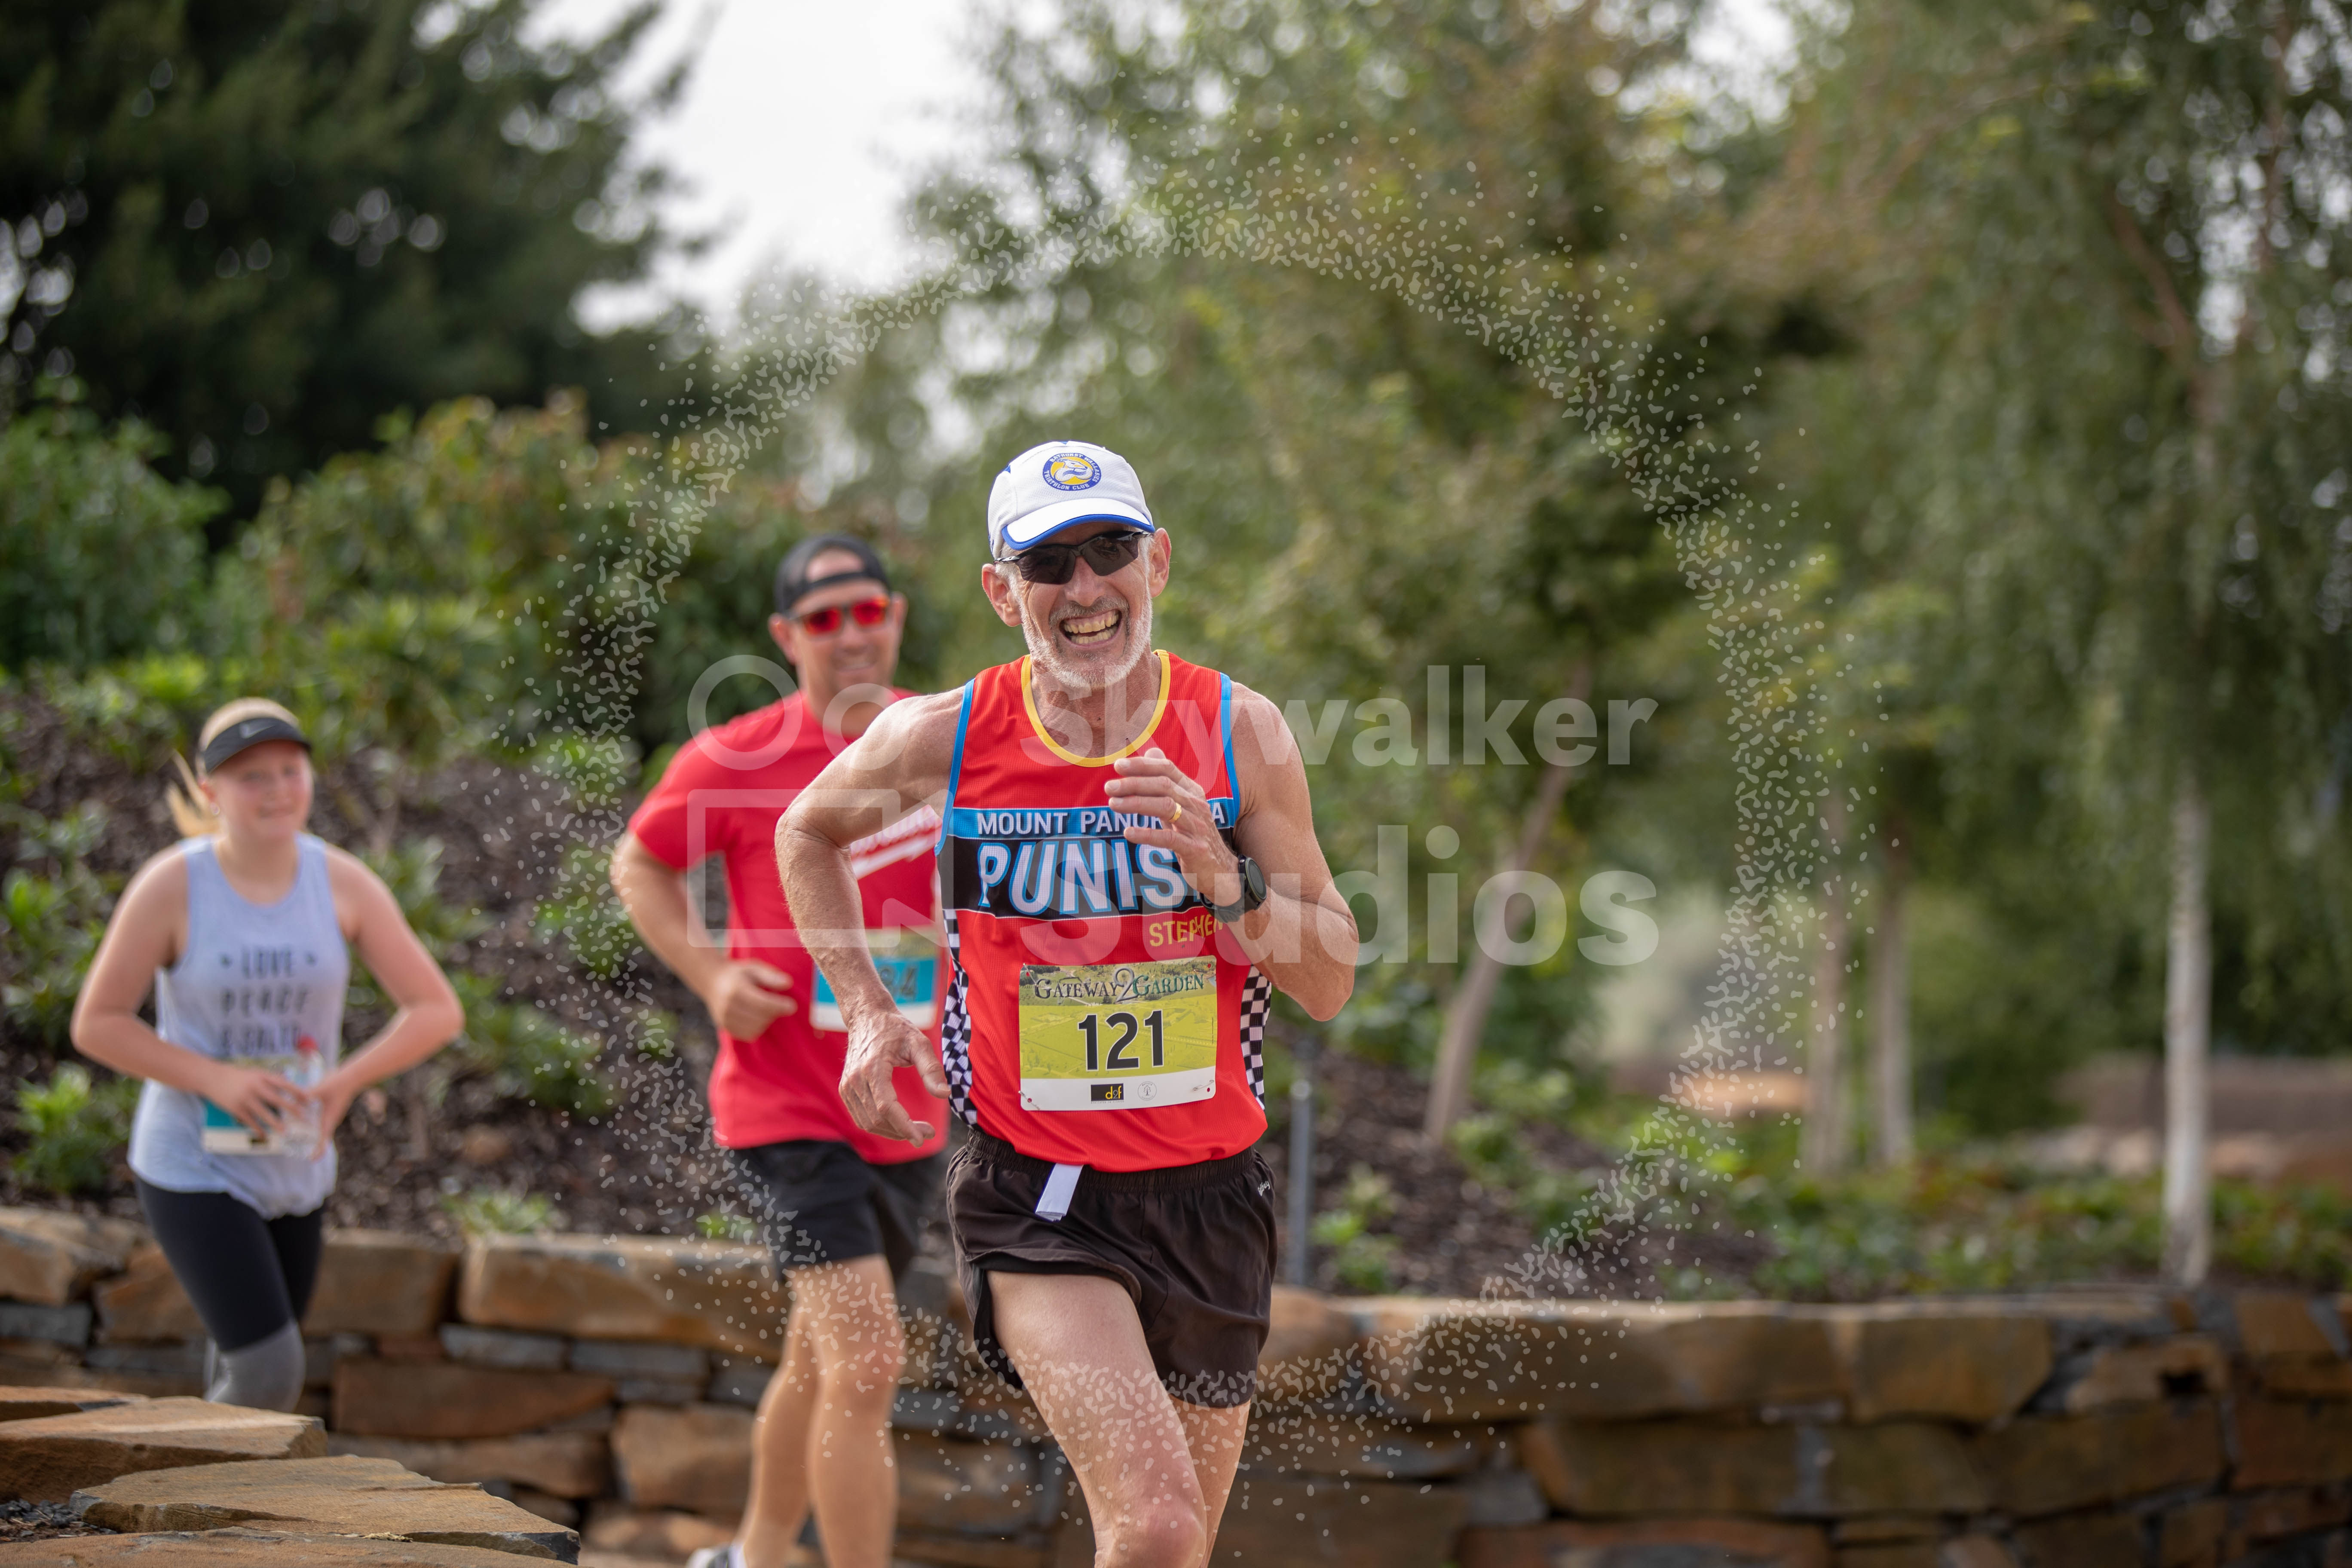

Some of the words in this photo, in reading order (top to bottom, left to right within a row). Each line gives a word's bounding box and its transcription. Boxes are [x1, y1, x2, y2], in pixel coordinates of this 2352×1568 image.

[1044, 470, 1070, 490] TRIATHLON
[1049, 453, 1083, 462] BATHURST
[1084, 457, 1100, 482] WALLABIES
[977, 812, 1068, 835] MOUNT
[977, 839, 1201, 915] PUNIS
[1078, 1009, 1164, 1071] 121
[1105, 1085, 1122, 1099] d2f
